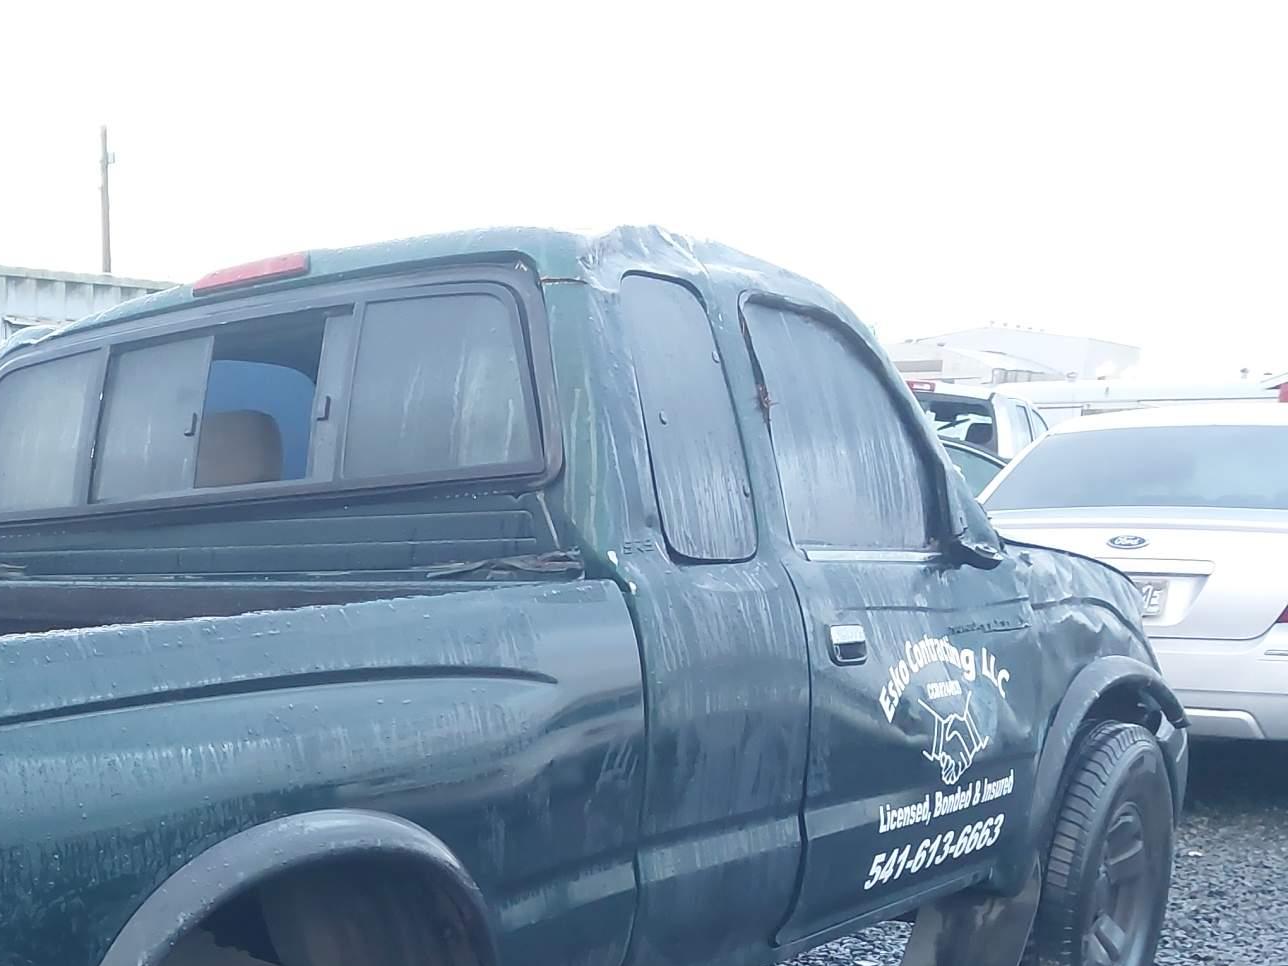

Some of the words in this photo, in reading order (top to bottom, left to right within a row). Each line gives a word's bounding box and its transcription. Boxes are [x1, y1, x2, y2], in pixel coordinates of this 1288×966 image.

[879, 658, 910, 724] Esko
[904, 634, 976, 682] Contracting
[878, 793, 932, 834] Licensed,
[933, 782, 973, 818] Bonded
[972, 780, 982, 806] &
[981, 768, 1015, 803] Insured
[863, 813, 1005, 890] 541-613-6663
